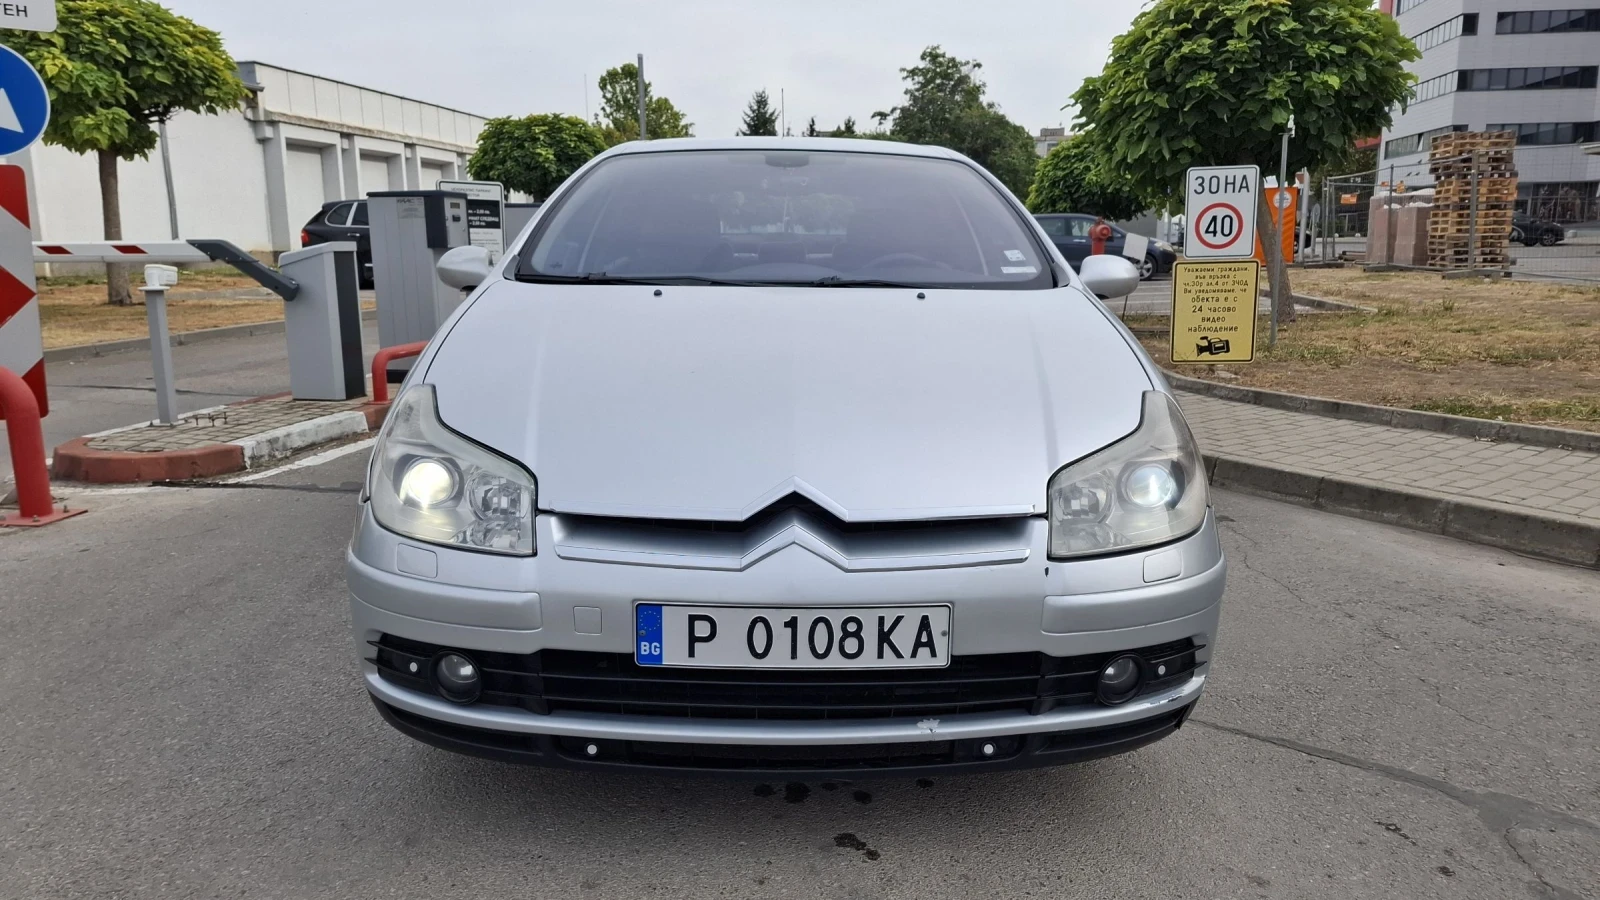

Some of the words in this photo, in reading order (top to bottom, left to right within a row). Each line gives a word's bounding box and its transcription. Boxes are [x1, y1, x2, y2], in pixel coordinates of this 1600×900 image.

[0, 2, 28, 18] ЕН
[1193, 174, 1250, 195] ЗОНА
[1204, 214, 1234, 238] 40
[1191, 295, 1220, 303] обекта
[1192, 305, 1203, 313] 24
[1187, 325, 1239, 333] наблюдение
[640, 641, 661, 655] BG
